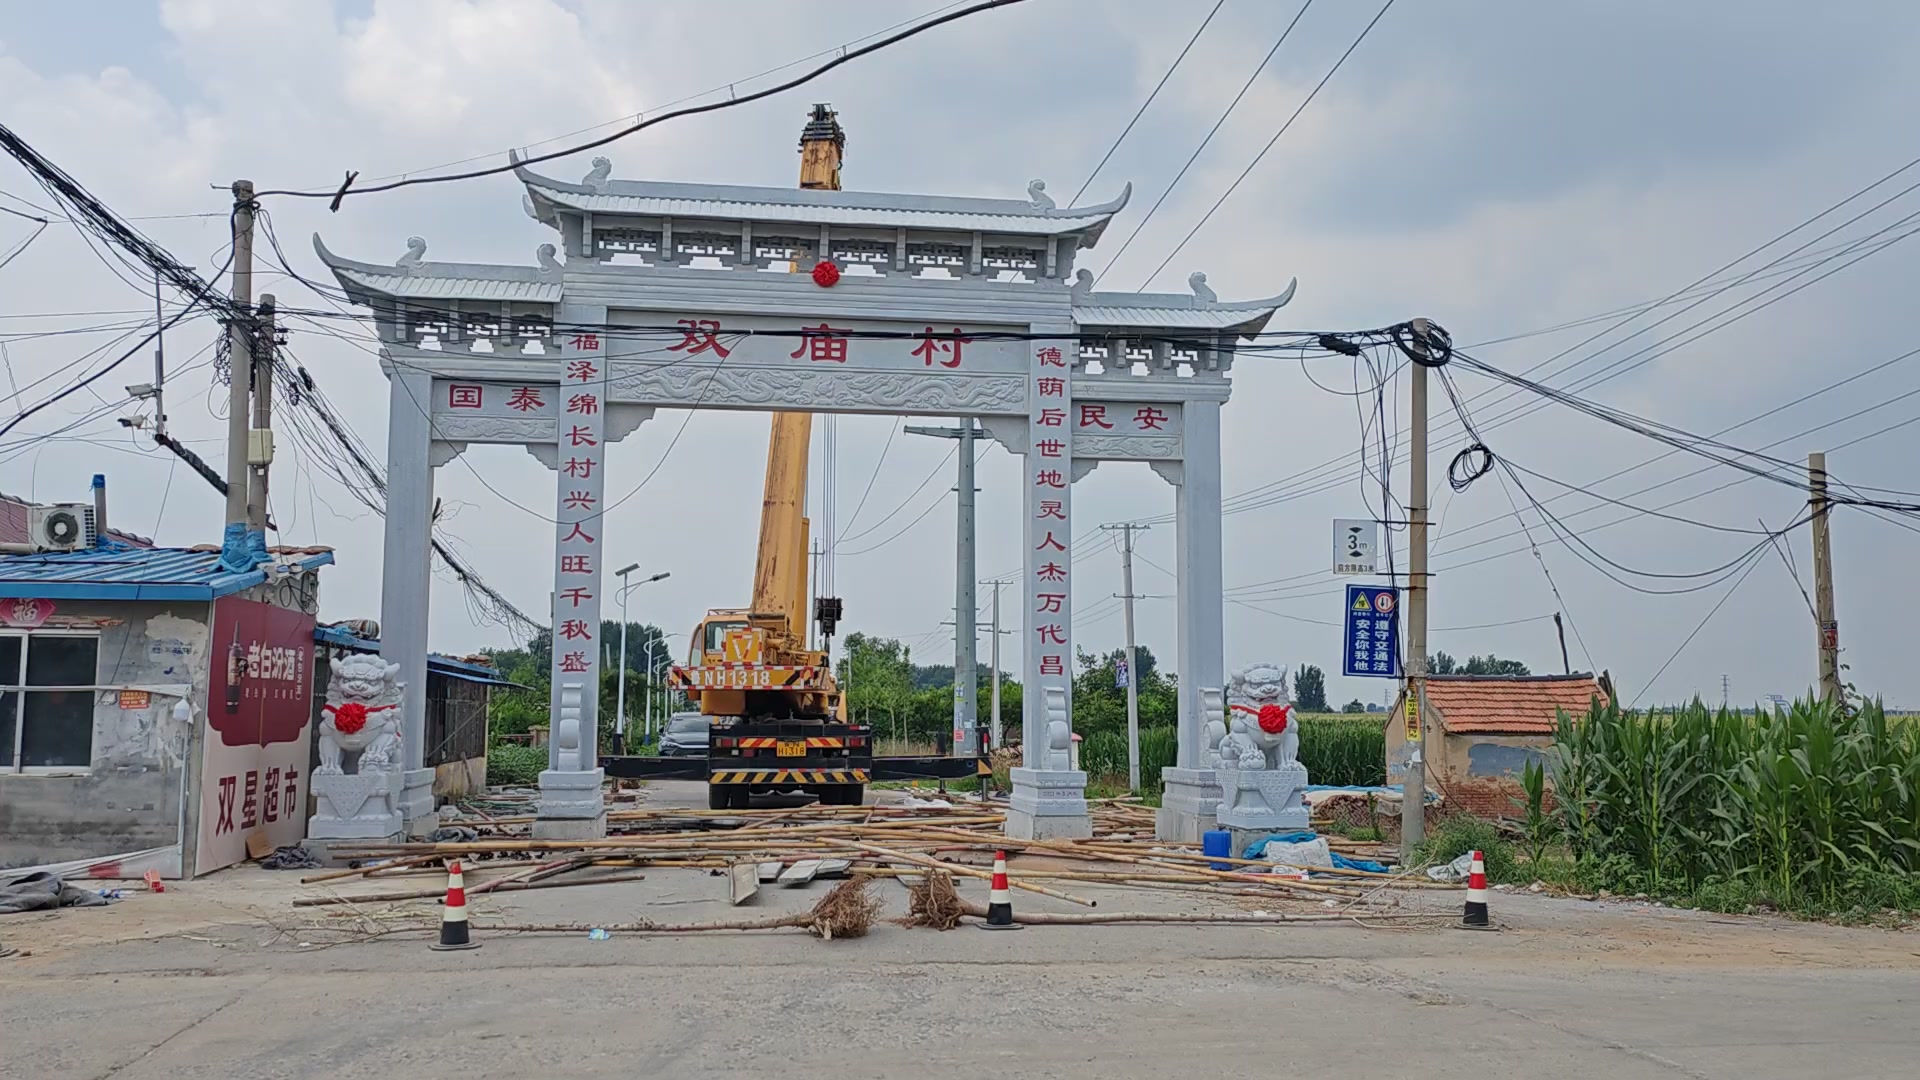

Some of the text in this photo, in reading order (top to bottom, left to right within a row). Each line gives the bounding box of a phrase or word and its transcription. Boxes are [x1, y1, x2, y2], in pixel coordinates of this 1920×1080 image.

[666, 319, 972, 368] 双庙村
[449, 384, 546, 412] 国泰
[1079, 405, 1169, 431] 民安
[557, 332, 600, 673] 福泽绵长村兴人旺千秋盛
[1036, 346, 1067, 676] 德荫后世地灵人杰万代昌
[246, 640, 296, 680] 老白汾酒
[1353, 618, 1371, 671] 安全你我他
[1372, 619, 1390, 672] 遵守交通法
[215, 764, 299, 837] 双星超市
